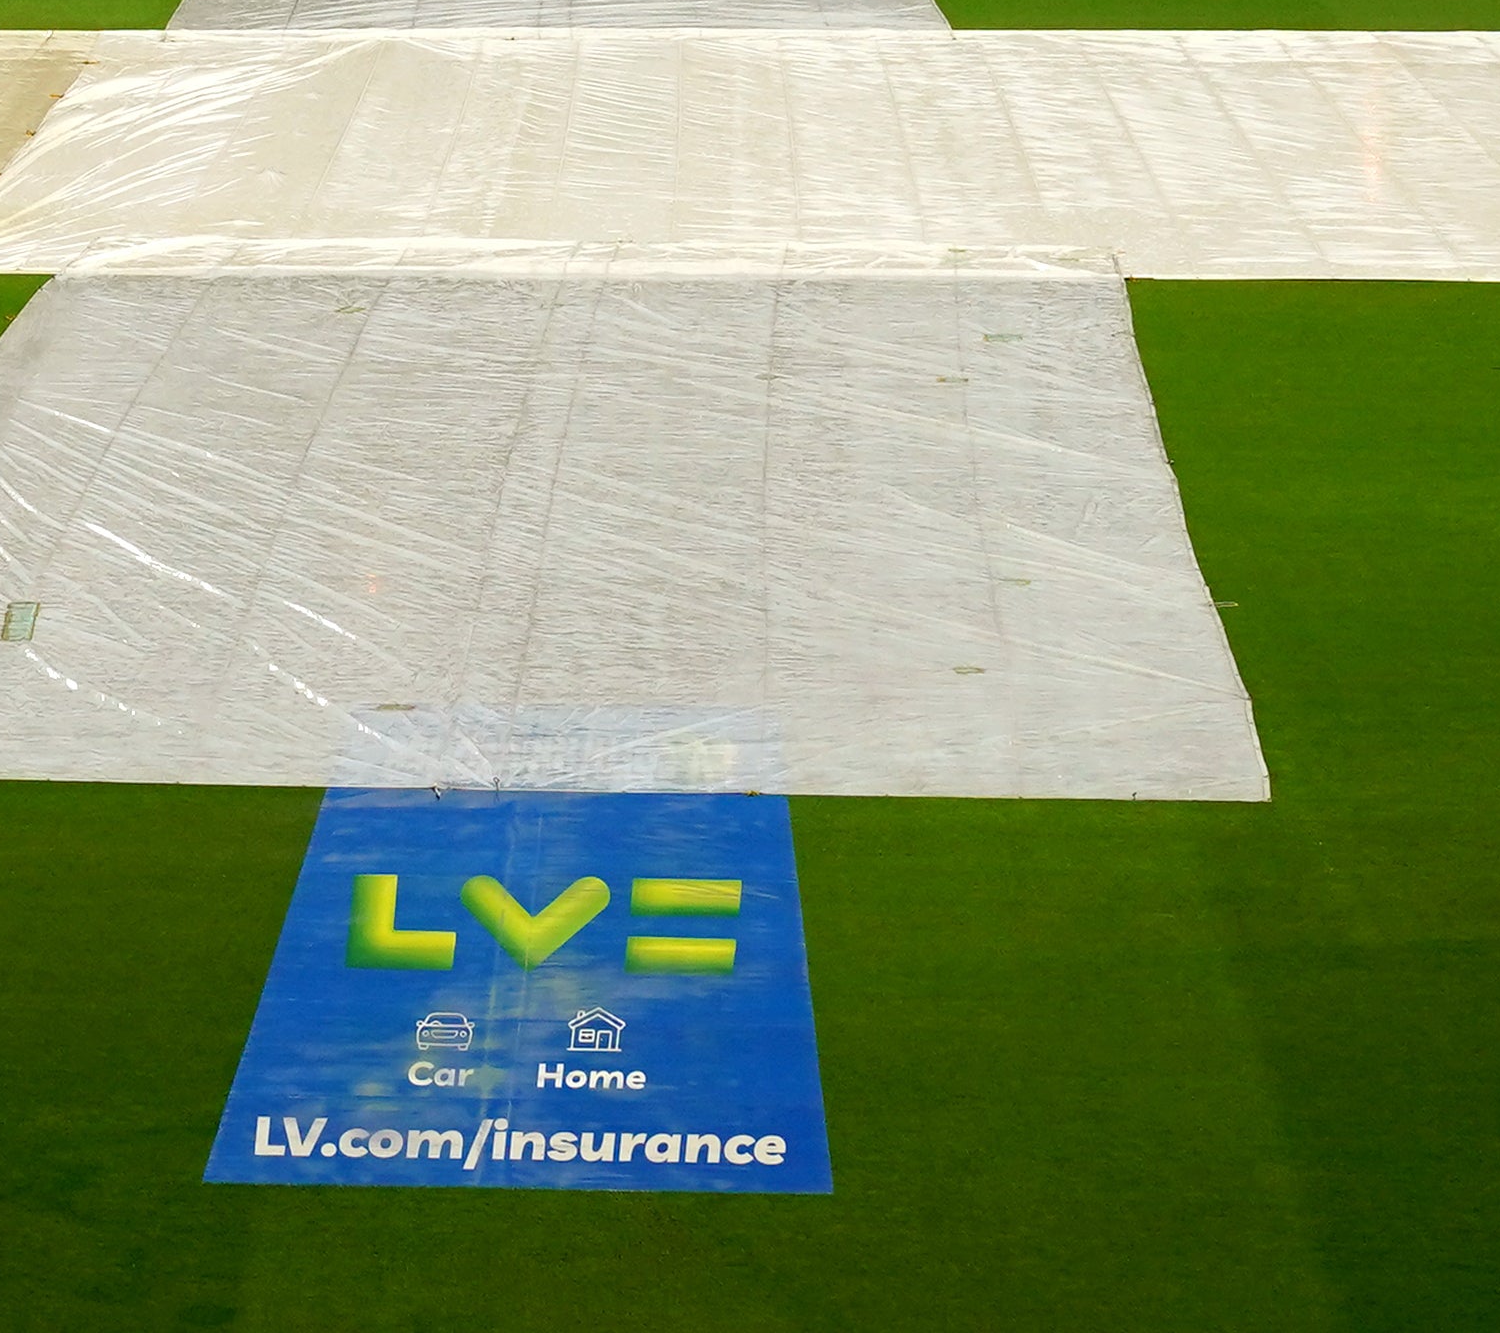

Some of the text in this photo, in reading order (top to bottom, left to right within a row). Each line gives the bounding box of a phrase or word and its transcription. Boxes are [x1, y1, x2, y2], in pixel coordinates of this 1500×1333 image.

[408, 1061, 647, 1091] Car Home
[252, 1115, 787, 1171] LV.com/insurance
